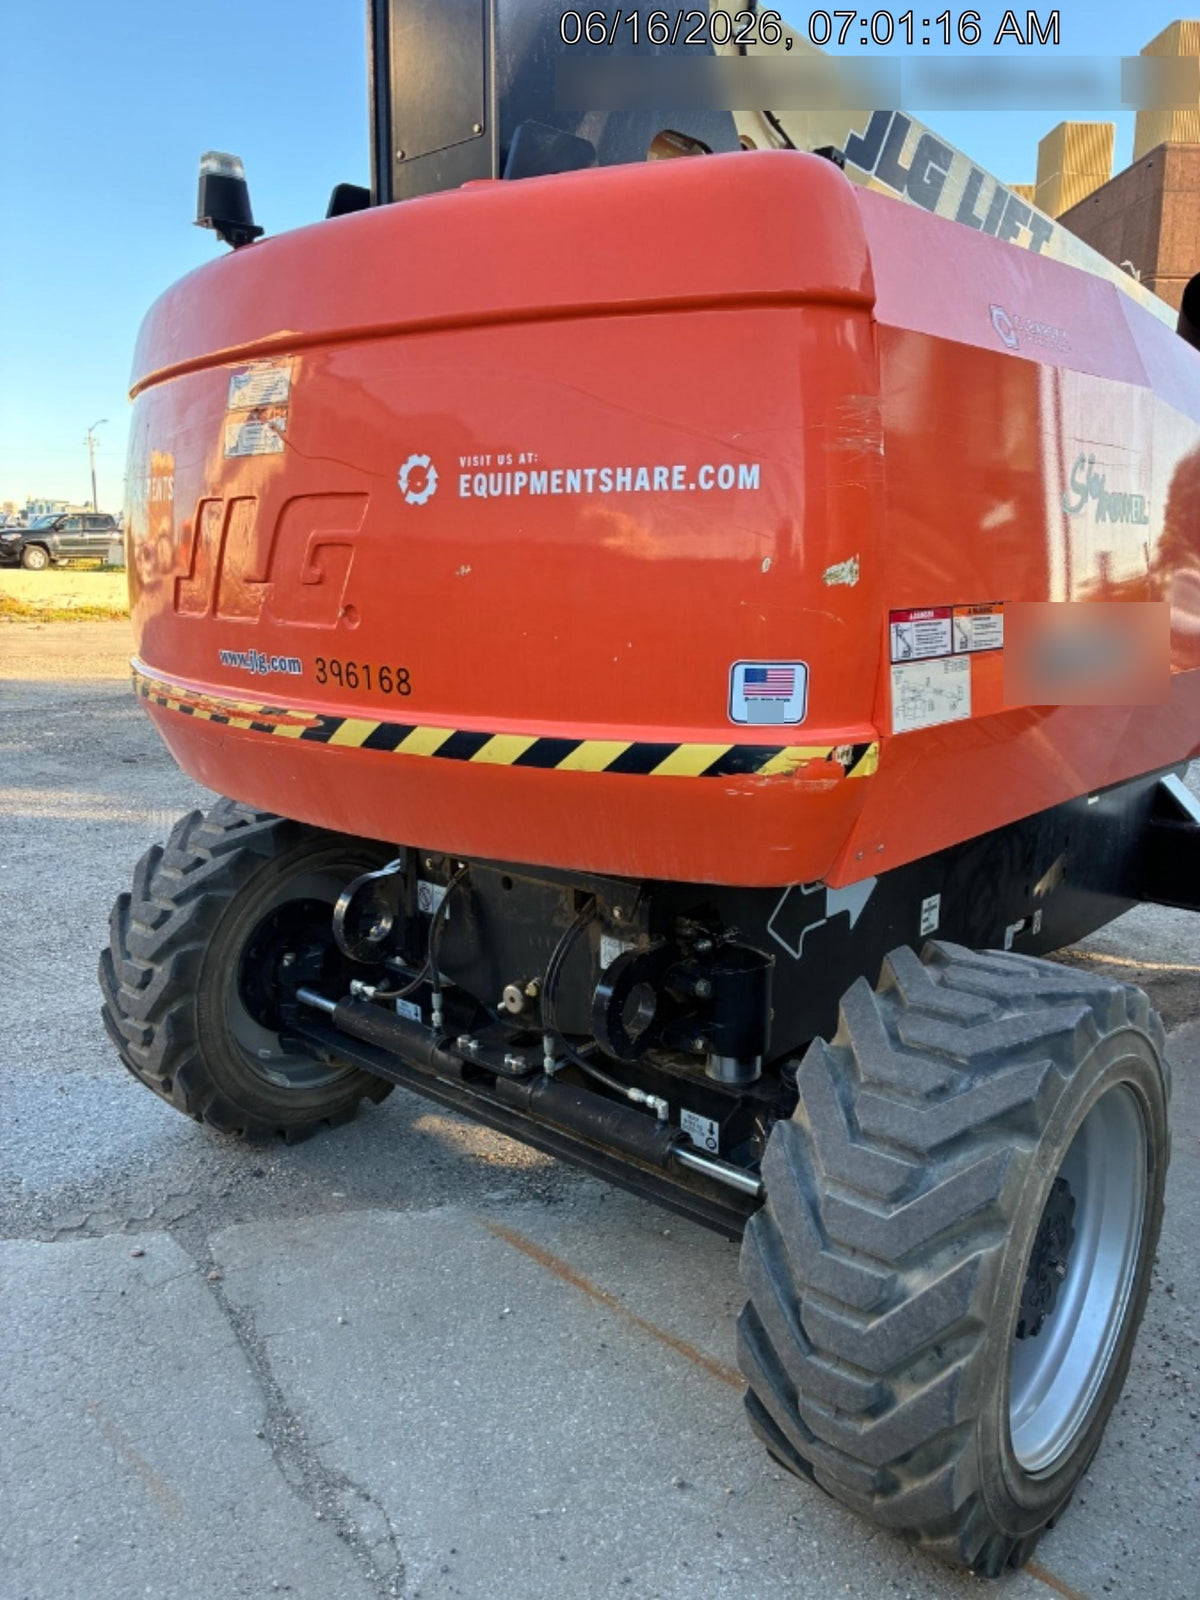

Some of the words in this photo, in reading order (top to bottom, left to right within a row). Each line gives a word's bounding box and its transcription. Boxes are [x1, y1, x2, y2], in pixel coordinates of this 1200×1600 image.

[844, 110, 955, 214] JLG
[954, 165, 1055, 255] LIFT
[459, 455, 492, 468] VISIT
[497, 453, 513, 465] US
[518, 452, 538, 464] AT:
[459, 463, 760, 499] EQUIPMENTSHARE.COM
[173, 491, 371, 630] JLG
[218, 649, 303, 676] www.jlg.com
[314, 657, 412, 697] 396168
